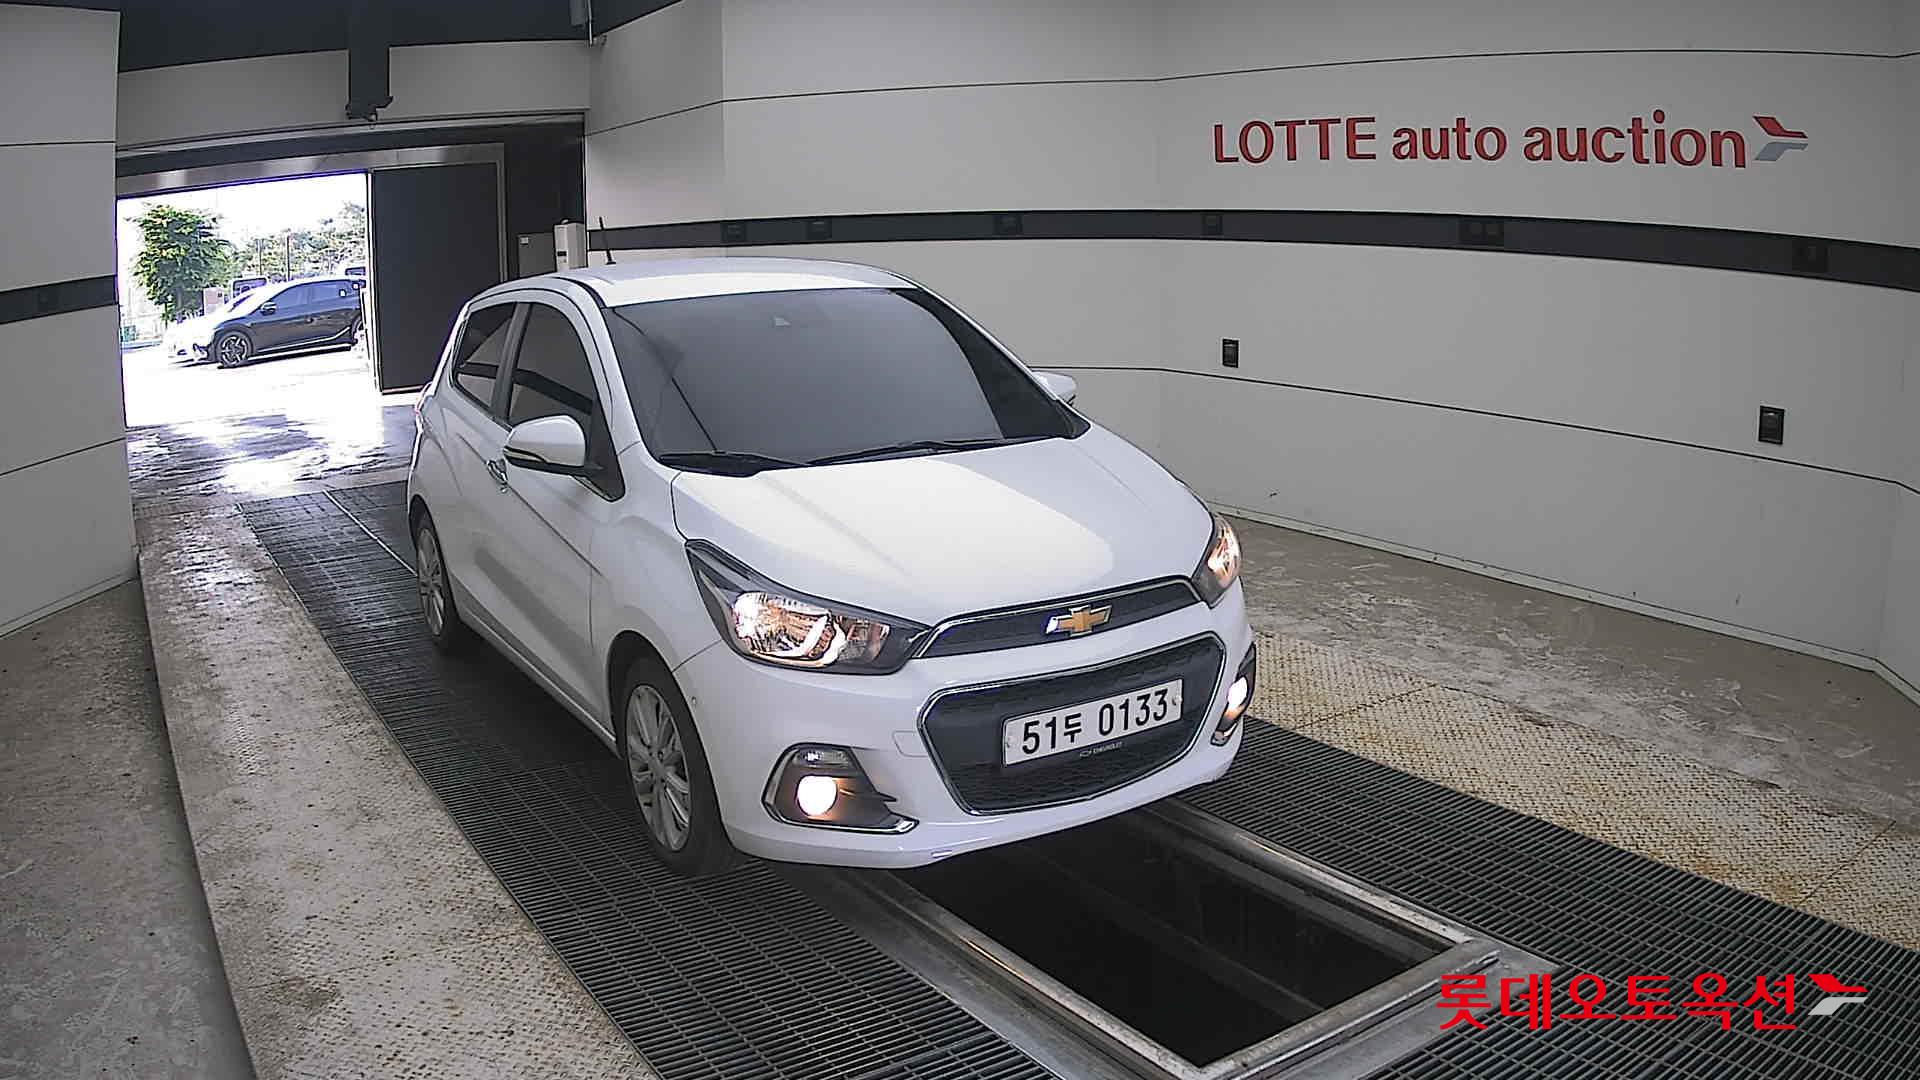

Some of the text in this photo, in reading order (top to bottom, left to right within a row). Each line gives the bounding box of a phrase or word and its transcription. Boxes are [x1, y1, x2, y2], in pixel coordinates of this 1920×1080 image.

[1213, 109, 1748, 169] LOTTE auto auction
[1022, 688, 1169, 755] 51두 0133
